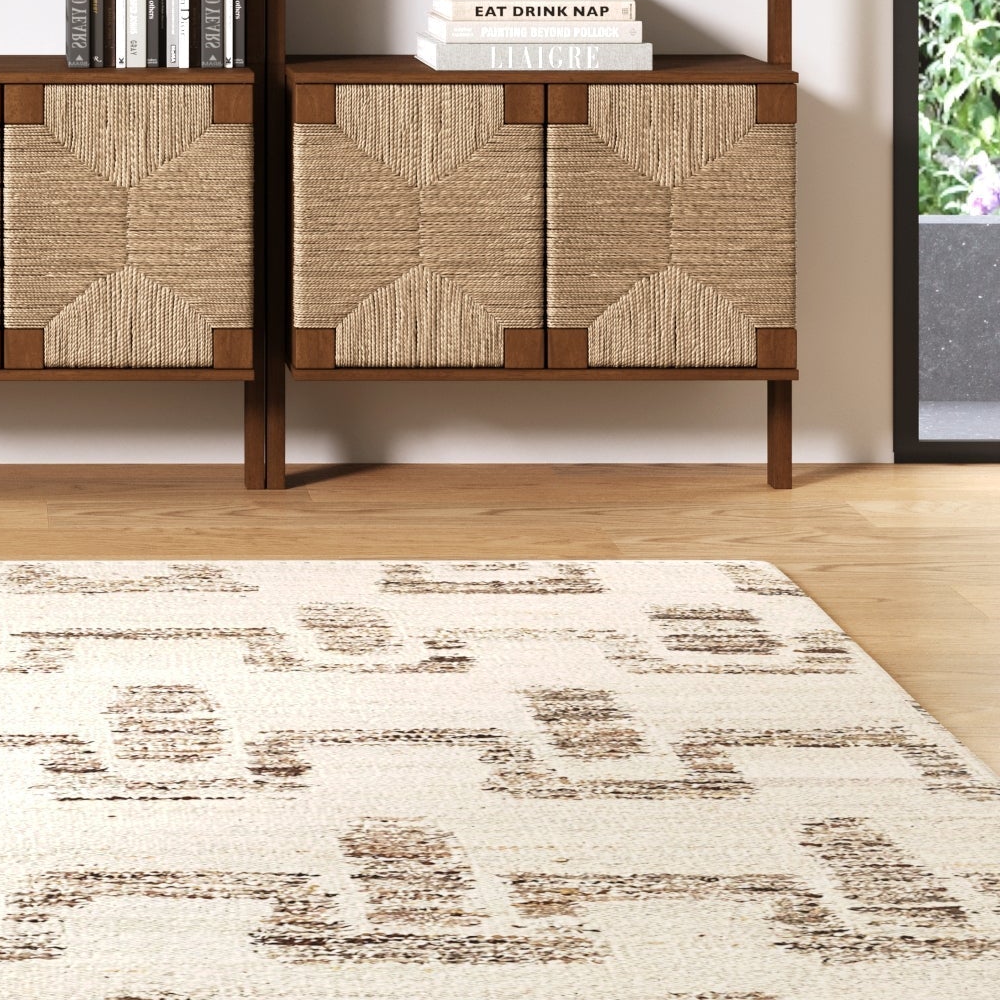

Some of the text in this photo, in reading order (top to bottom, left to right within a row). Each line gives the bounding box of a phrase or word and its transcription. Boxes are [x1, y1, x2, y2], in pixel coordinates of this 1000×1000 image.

[475, 6, 610, 17] EAT DRINK NAP
[481, 27, 527, 38] PAINTING
[530, 27, 571, 38] BEYOND
[574, 27, 620, 38] POLLOCK
[490, 45, 601, 70] LIAIGRE
